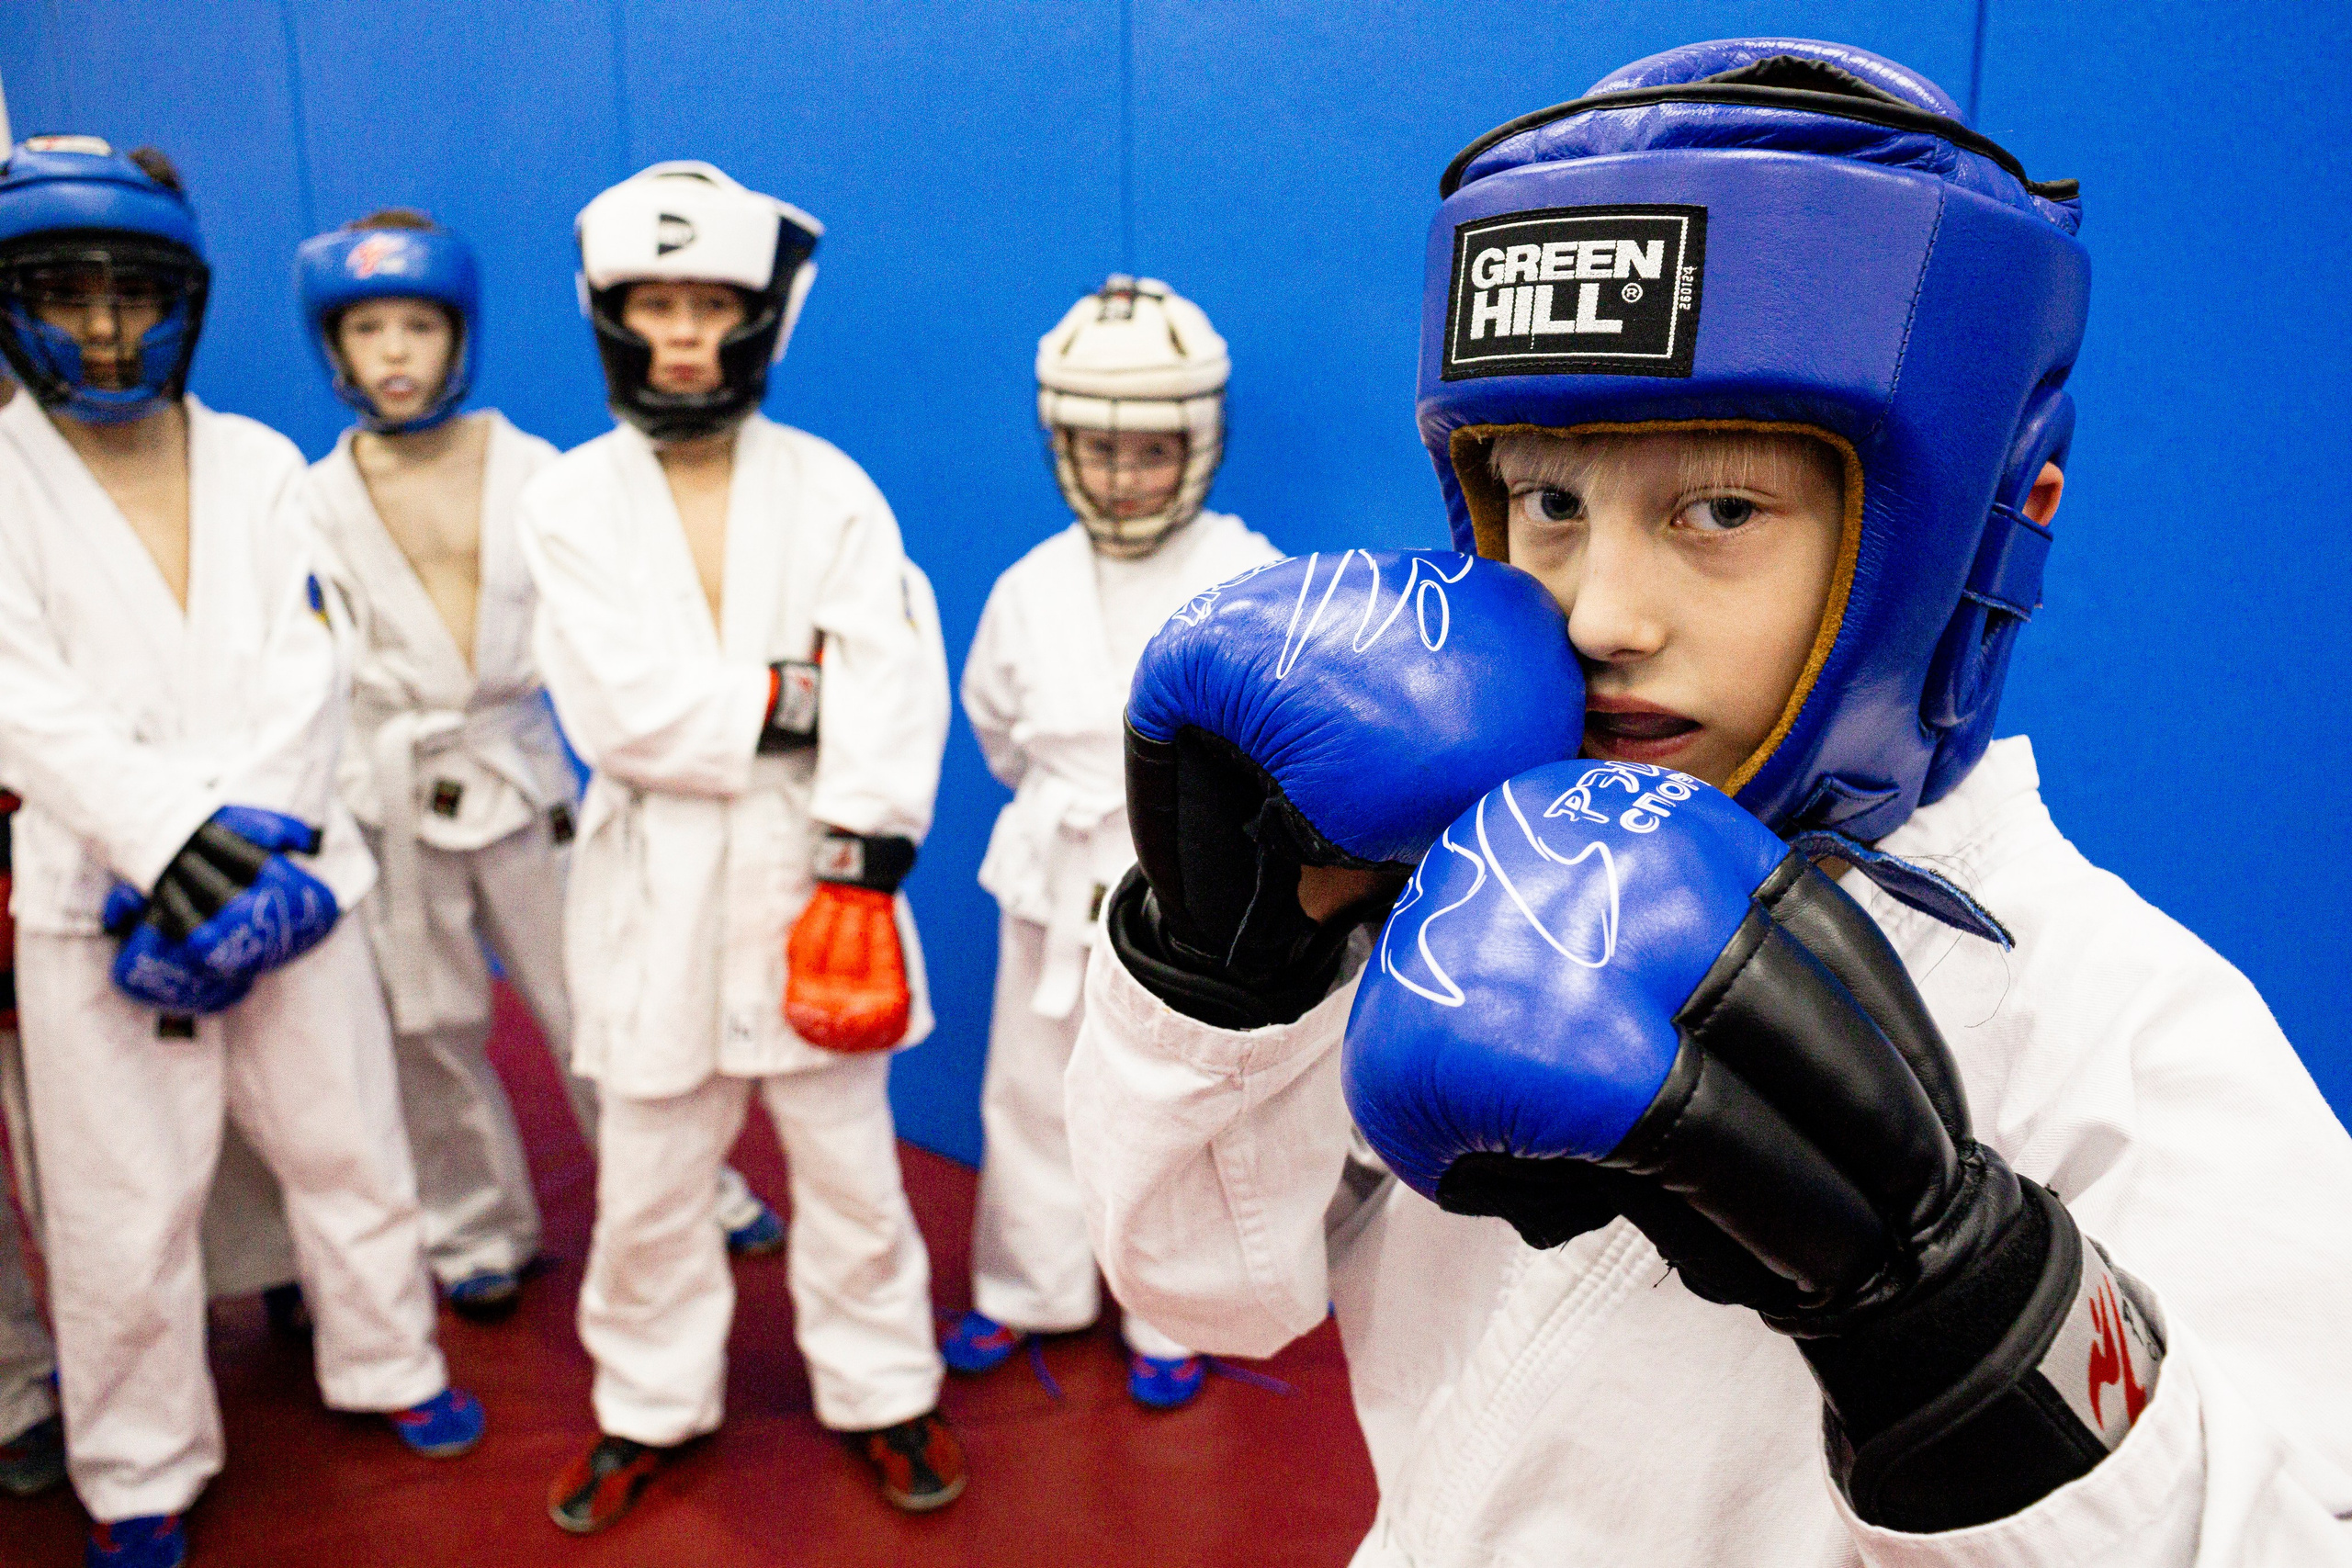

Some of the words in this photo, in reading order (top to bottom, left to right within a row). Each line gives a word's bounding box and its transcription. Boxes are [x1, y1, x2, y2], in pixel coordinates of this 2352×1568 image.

[1471, 240, 1665, 289] GREEN
[1679, 265, 1698, 310] 260124
[1470, 282, 1623, 340] HILL
[1619, 773, 1712, 834] СПОР
